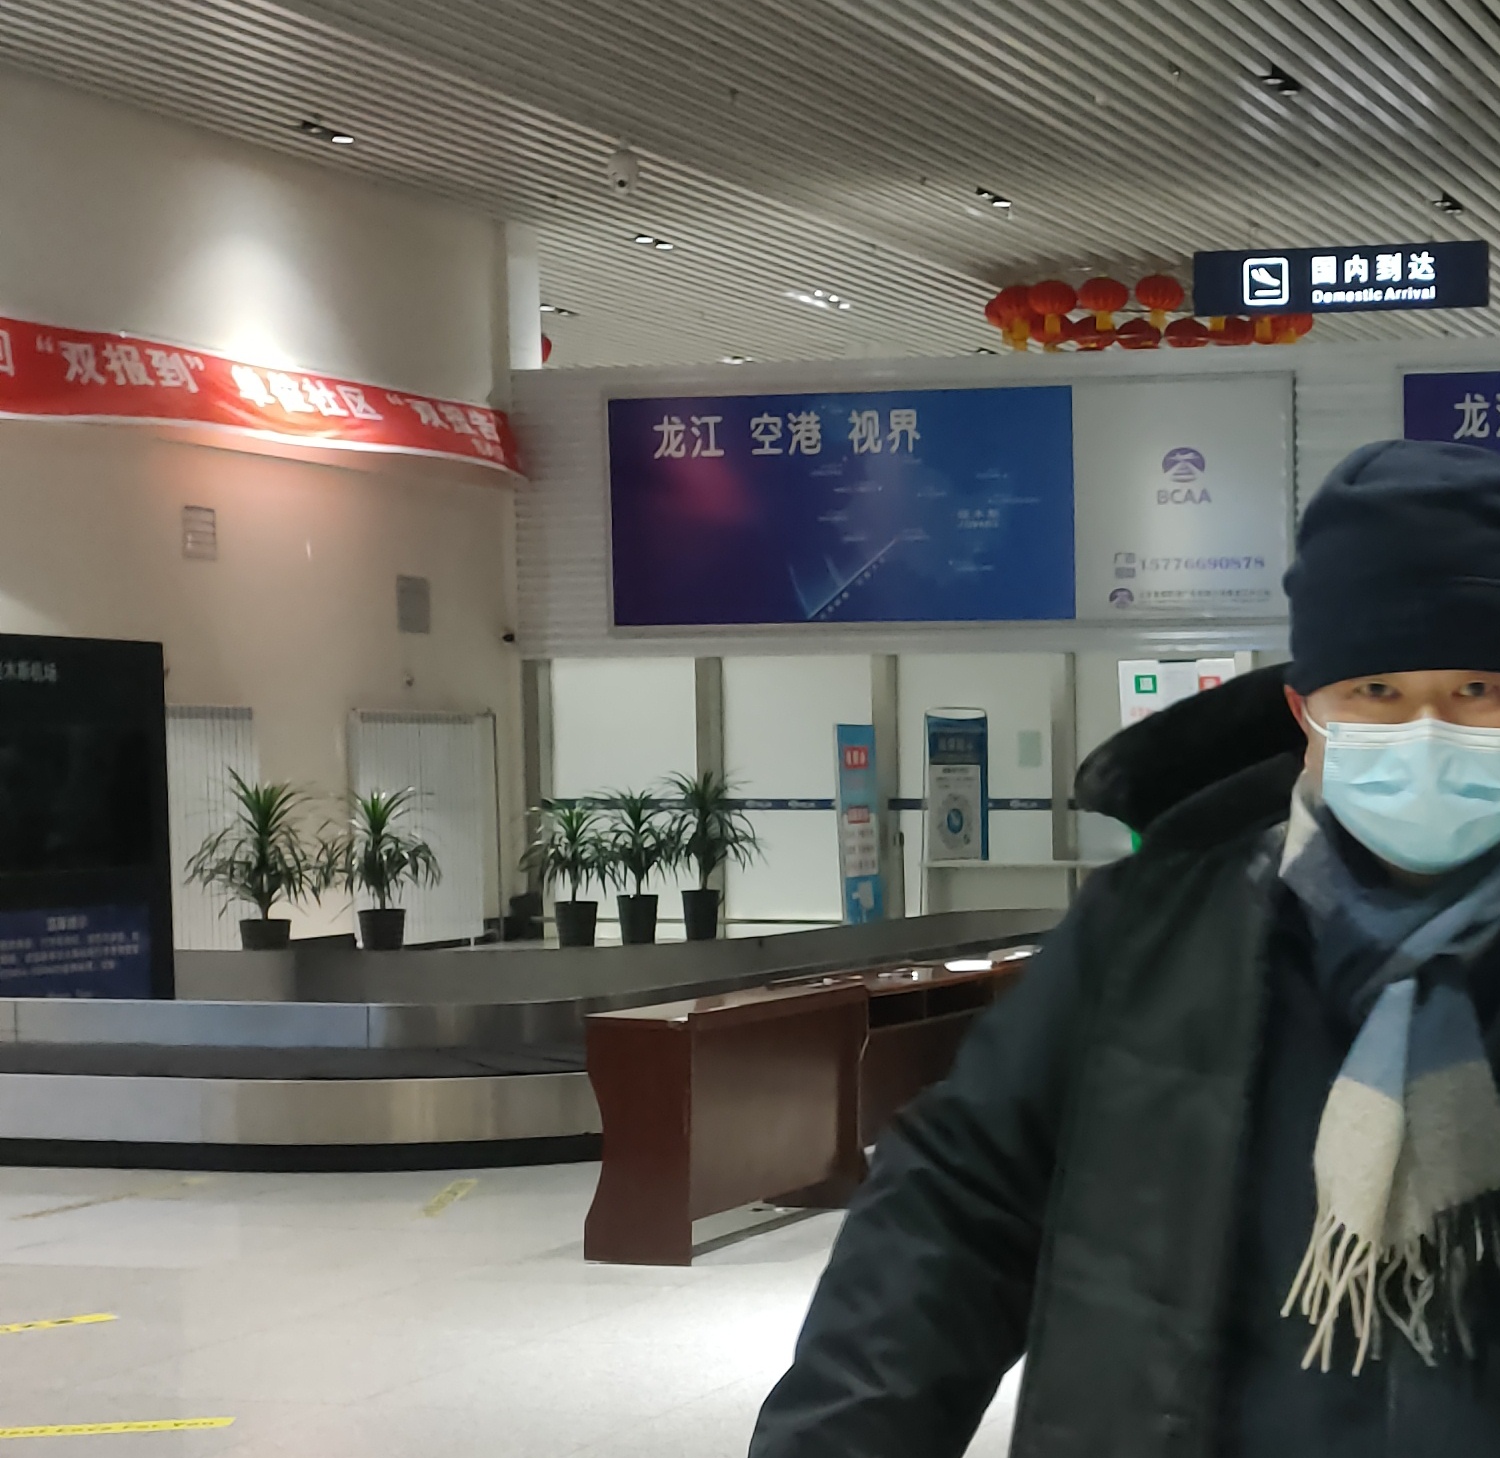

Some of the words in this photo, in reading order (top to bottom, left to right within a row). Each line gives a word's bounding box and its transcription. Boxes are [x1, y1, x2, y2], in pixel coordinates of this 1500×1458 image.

[1311, 251, 1436, 285] 国内到达
[1312, 288, 1383, 304] Domestic
[1384, 285, 1436, 301] Arrival
[653, 415, 724, 459] 龙江
[750, 411, 822, 456] 空港
[848, 408, 921, 453] 视界
[1157, 488, 1212, 505] BCAA
